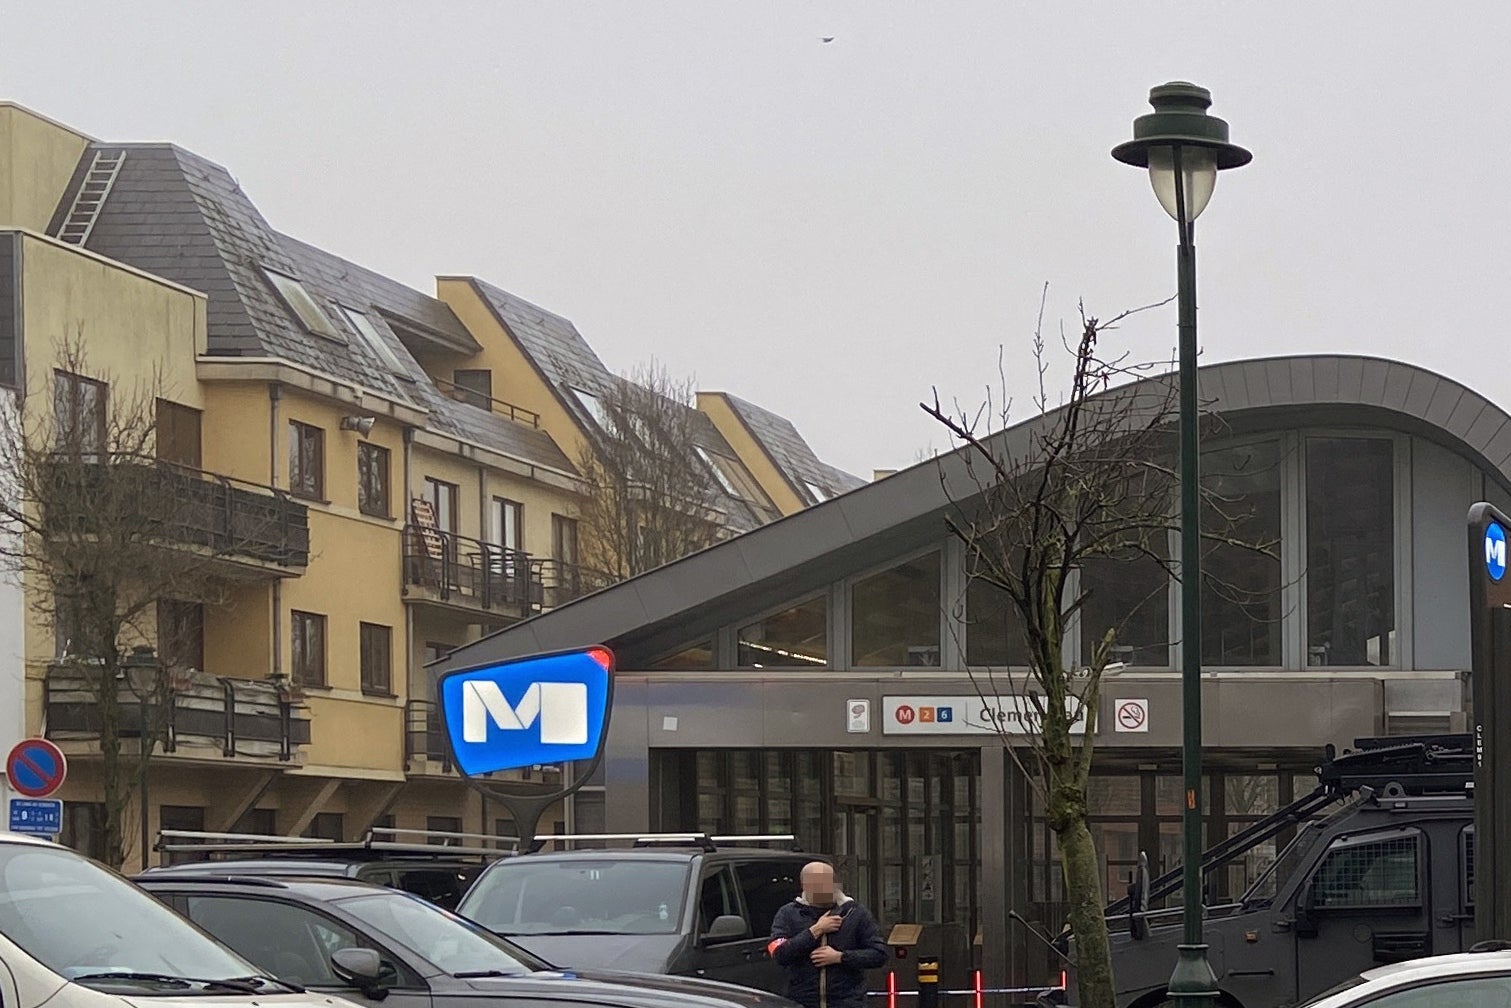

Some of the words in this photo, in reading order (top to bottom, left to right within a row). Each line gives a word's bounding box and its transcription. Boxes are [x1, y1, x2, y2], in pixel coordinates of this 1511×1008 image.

[1485, 537, 1507, 567] M
[463, 680, 588, 745] M
[899, 709, 912, 721] M
[923, 710, 930, 720] 2
[941, 710, 948, 720] 6
